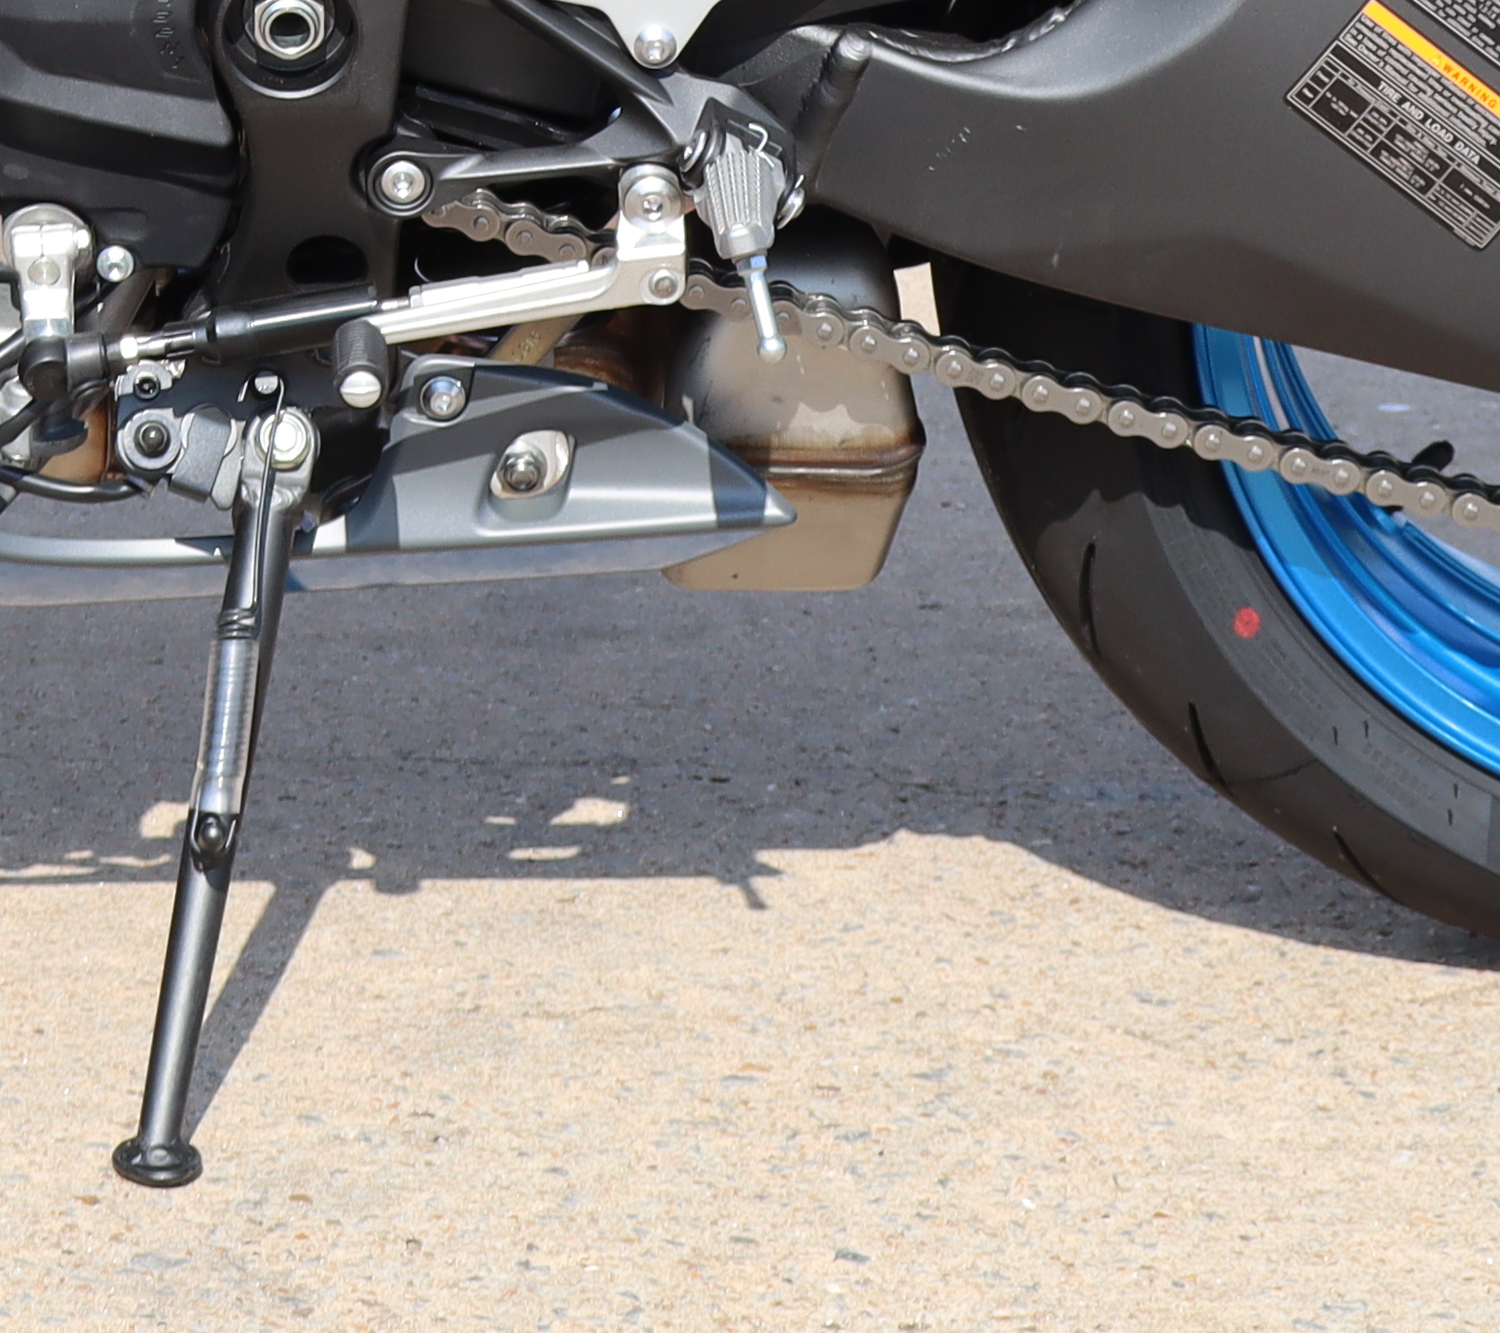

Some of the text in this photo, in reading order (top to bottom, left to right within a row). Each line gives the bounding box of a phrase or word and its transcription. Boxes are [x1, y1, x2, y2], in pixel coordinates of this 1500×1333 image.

[1441, 63, 1499, 110] WARNING
[1375, 80, 1482, 165] TIRE AND LOAD DATA
